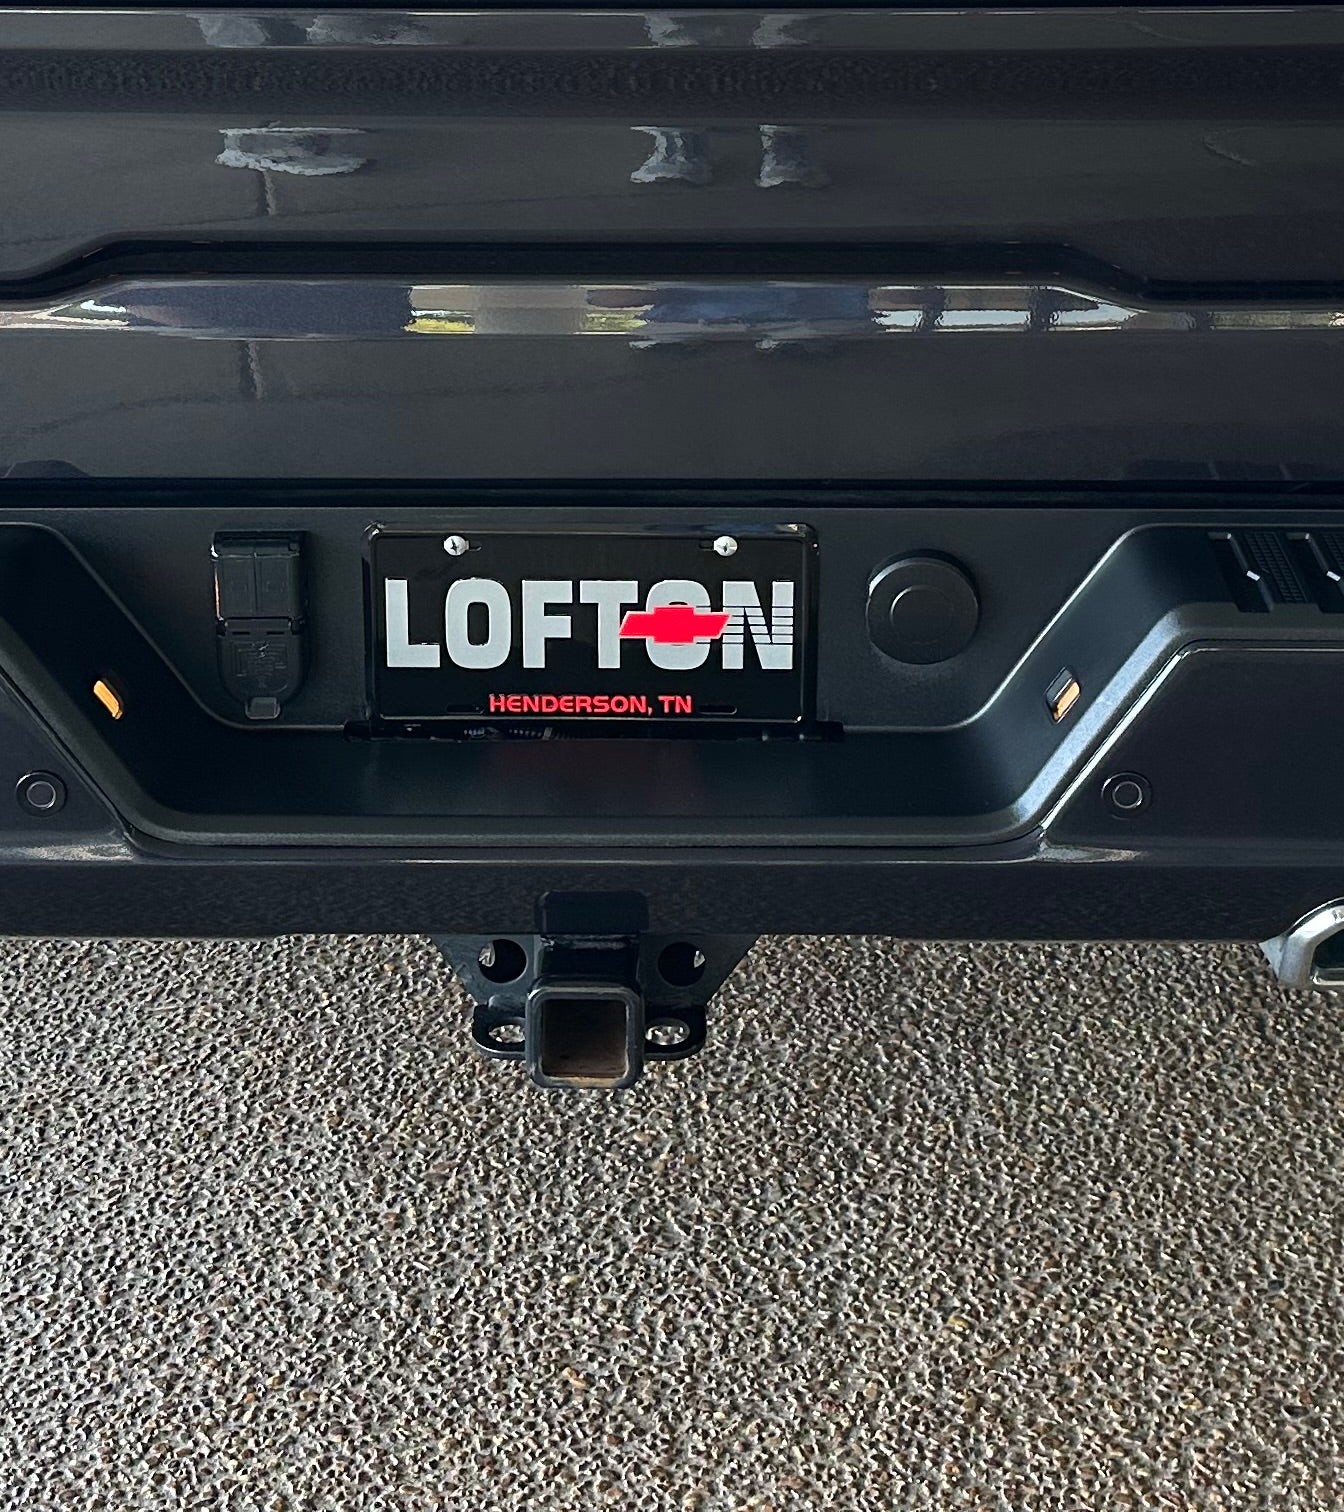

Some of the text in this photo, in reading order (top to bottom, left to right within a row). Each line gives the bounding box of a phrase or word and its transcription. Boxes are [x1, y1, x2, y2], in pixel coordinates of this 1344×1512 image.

[384, 578, 795, 670] LOFTON
[488, 694, 693, 716] HENDERSON, TN
